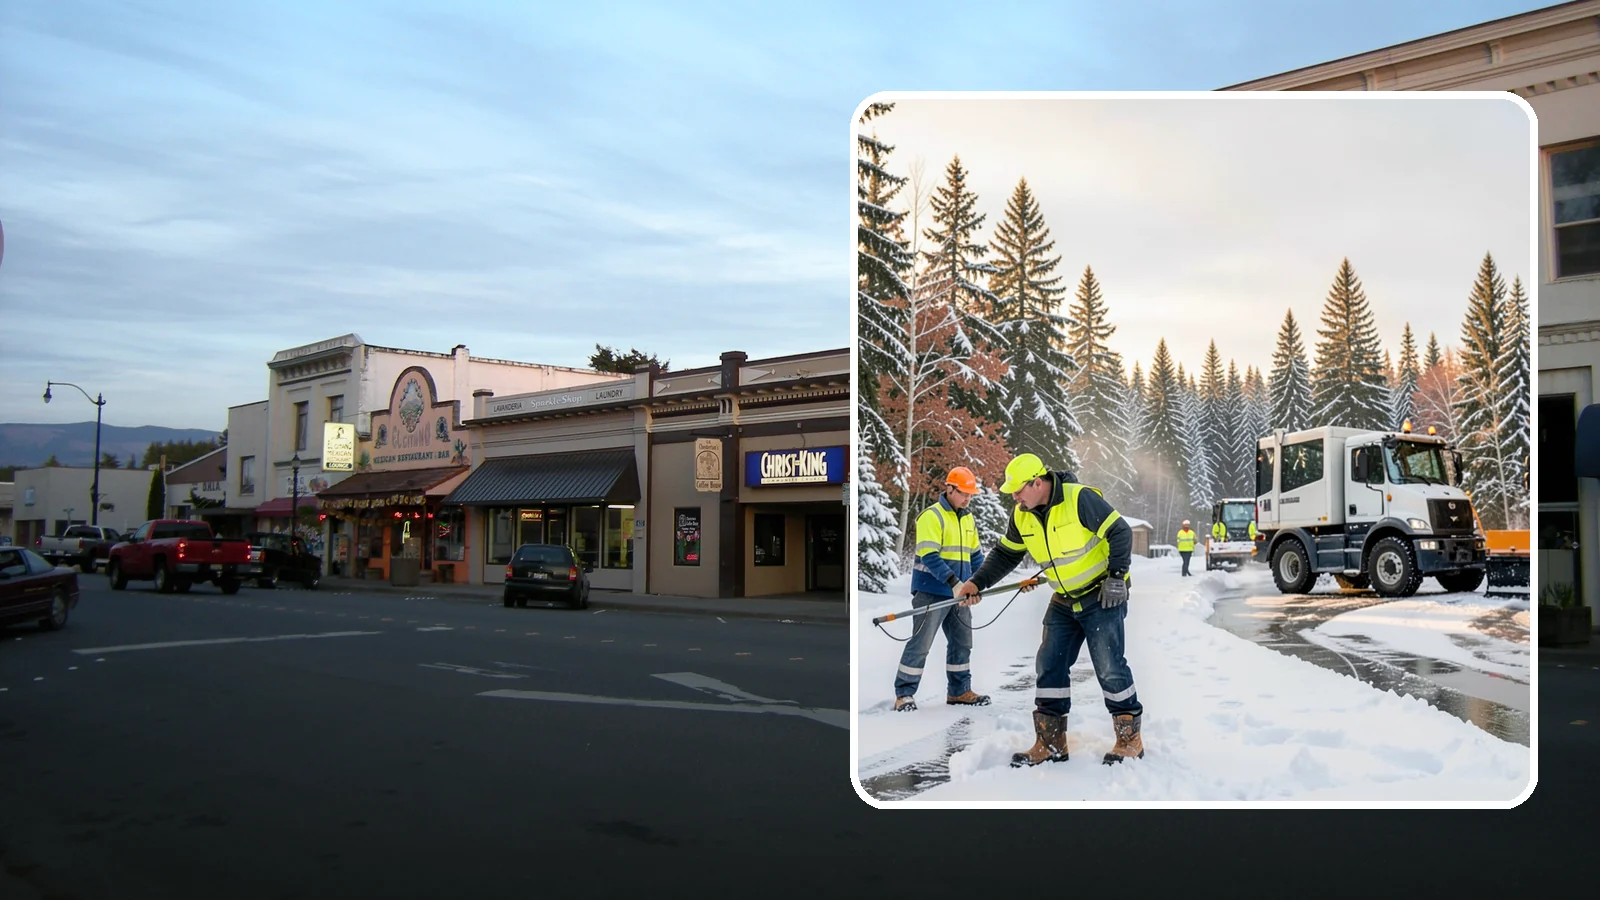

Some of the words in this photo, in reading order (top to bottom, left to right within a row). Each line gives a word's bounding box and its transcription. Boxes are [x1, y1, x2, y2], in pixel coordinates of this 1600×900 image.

[595, 389, 623, 400] LAUNDRY
[494, 402, 522, 412] LAVANDERIA
[530, 399, 560, 409] Sparkle
[560, 394, 582, 405] Shop
[374, 455, 396, 464] MEXICAN
[397, 452, 433, 463] RESTAURANT
[438, 450, 450, 459] BAR
